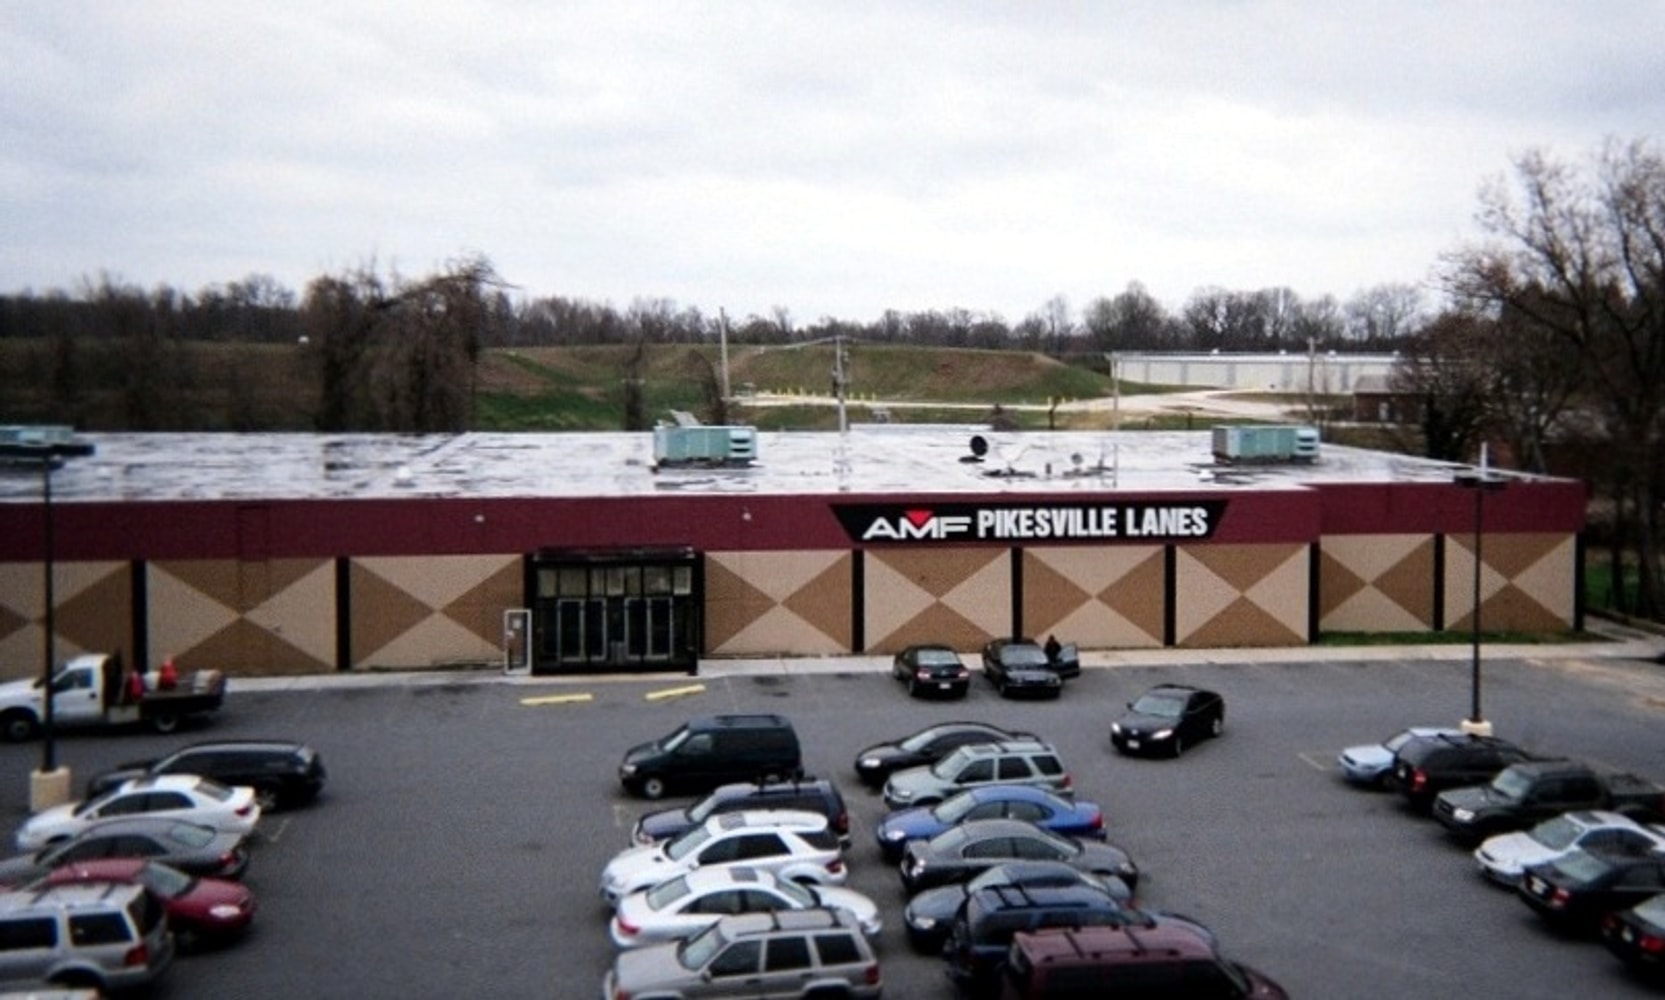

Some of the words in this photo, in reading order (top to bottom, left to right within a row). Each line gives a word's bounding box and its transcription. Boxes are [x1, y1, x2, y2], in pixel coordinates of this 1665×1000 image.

[862, 516, 972, 540] AMF
[977, 508, 1117, 538] PIKESVILLE
[1126, 507, 1209, 536] LANES
